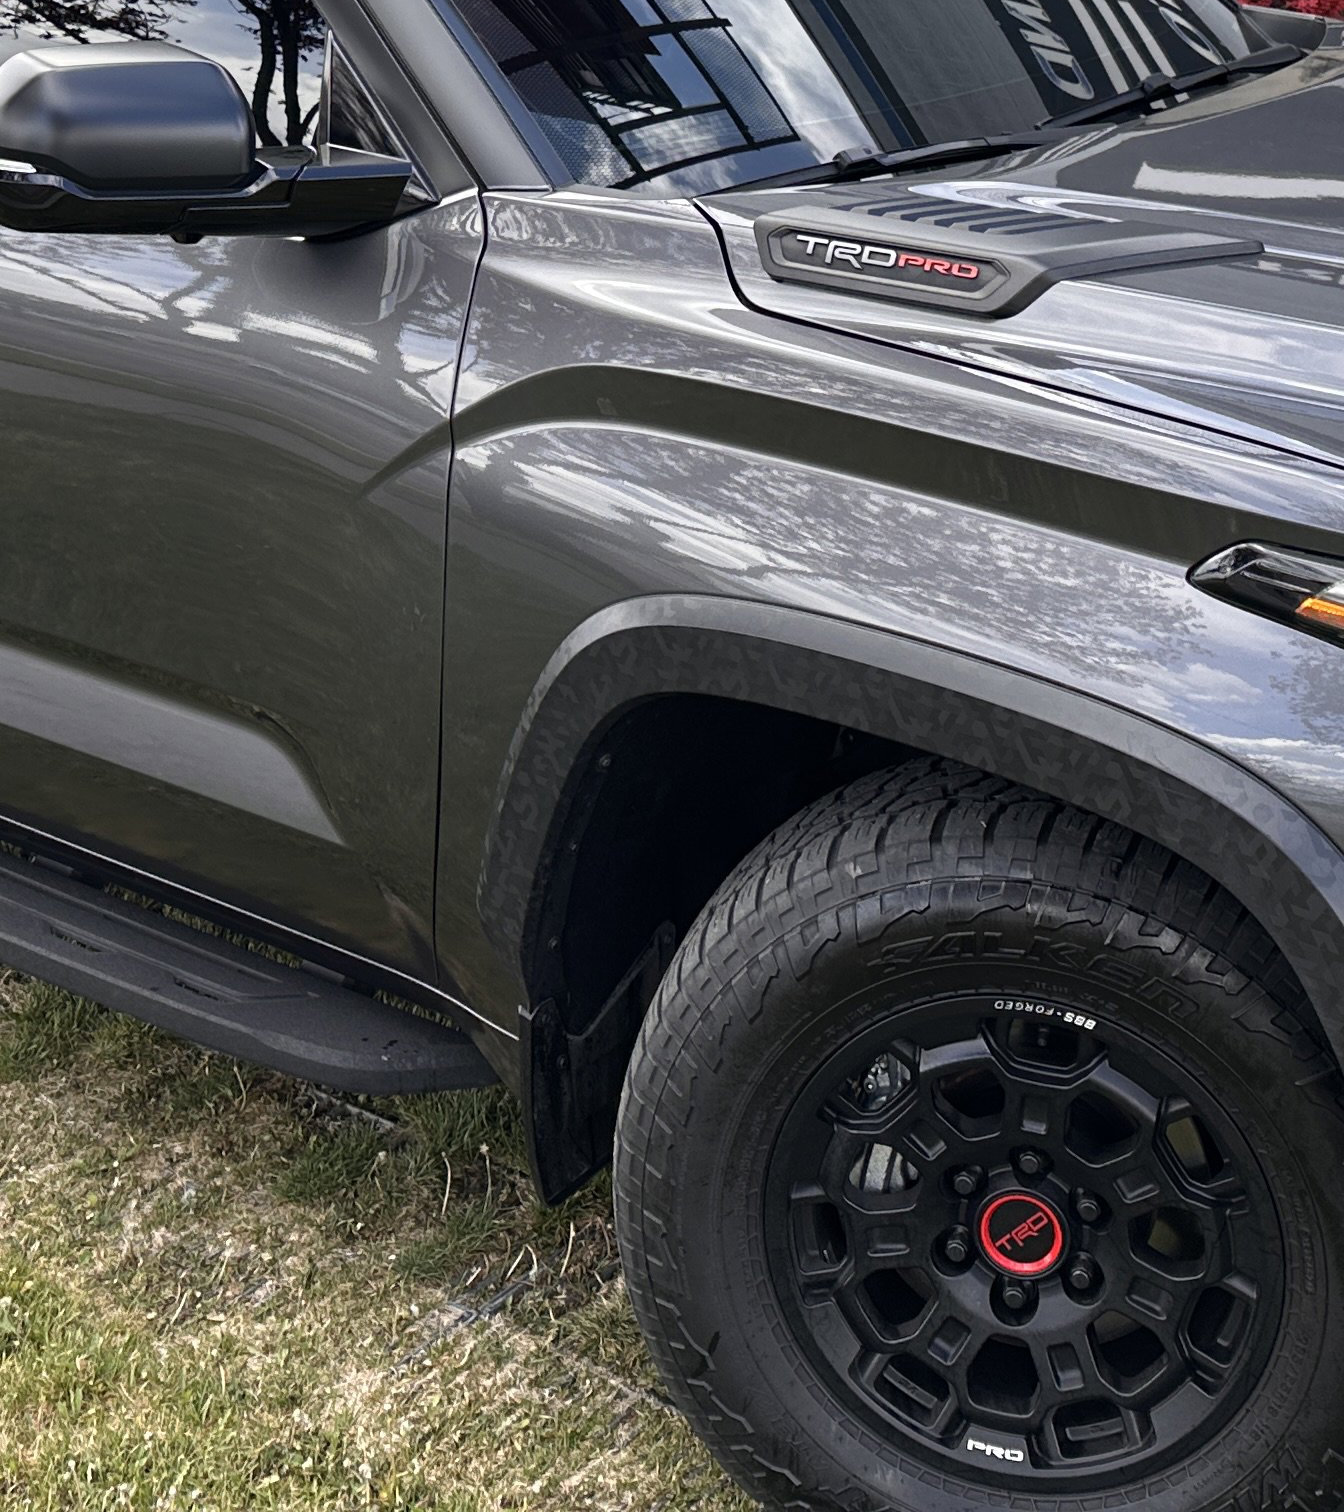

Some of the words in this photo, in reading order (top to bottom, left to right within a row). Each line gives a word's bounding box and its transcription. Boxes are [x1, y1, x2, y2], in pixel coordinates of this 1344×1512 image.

[796, 234, 897, 270] TRD
[898, 254, 980, 280] PRO
[995, 1210, 1050, 1252] TRD
[967, 1438, 1024, 1463] PRO
